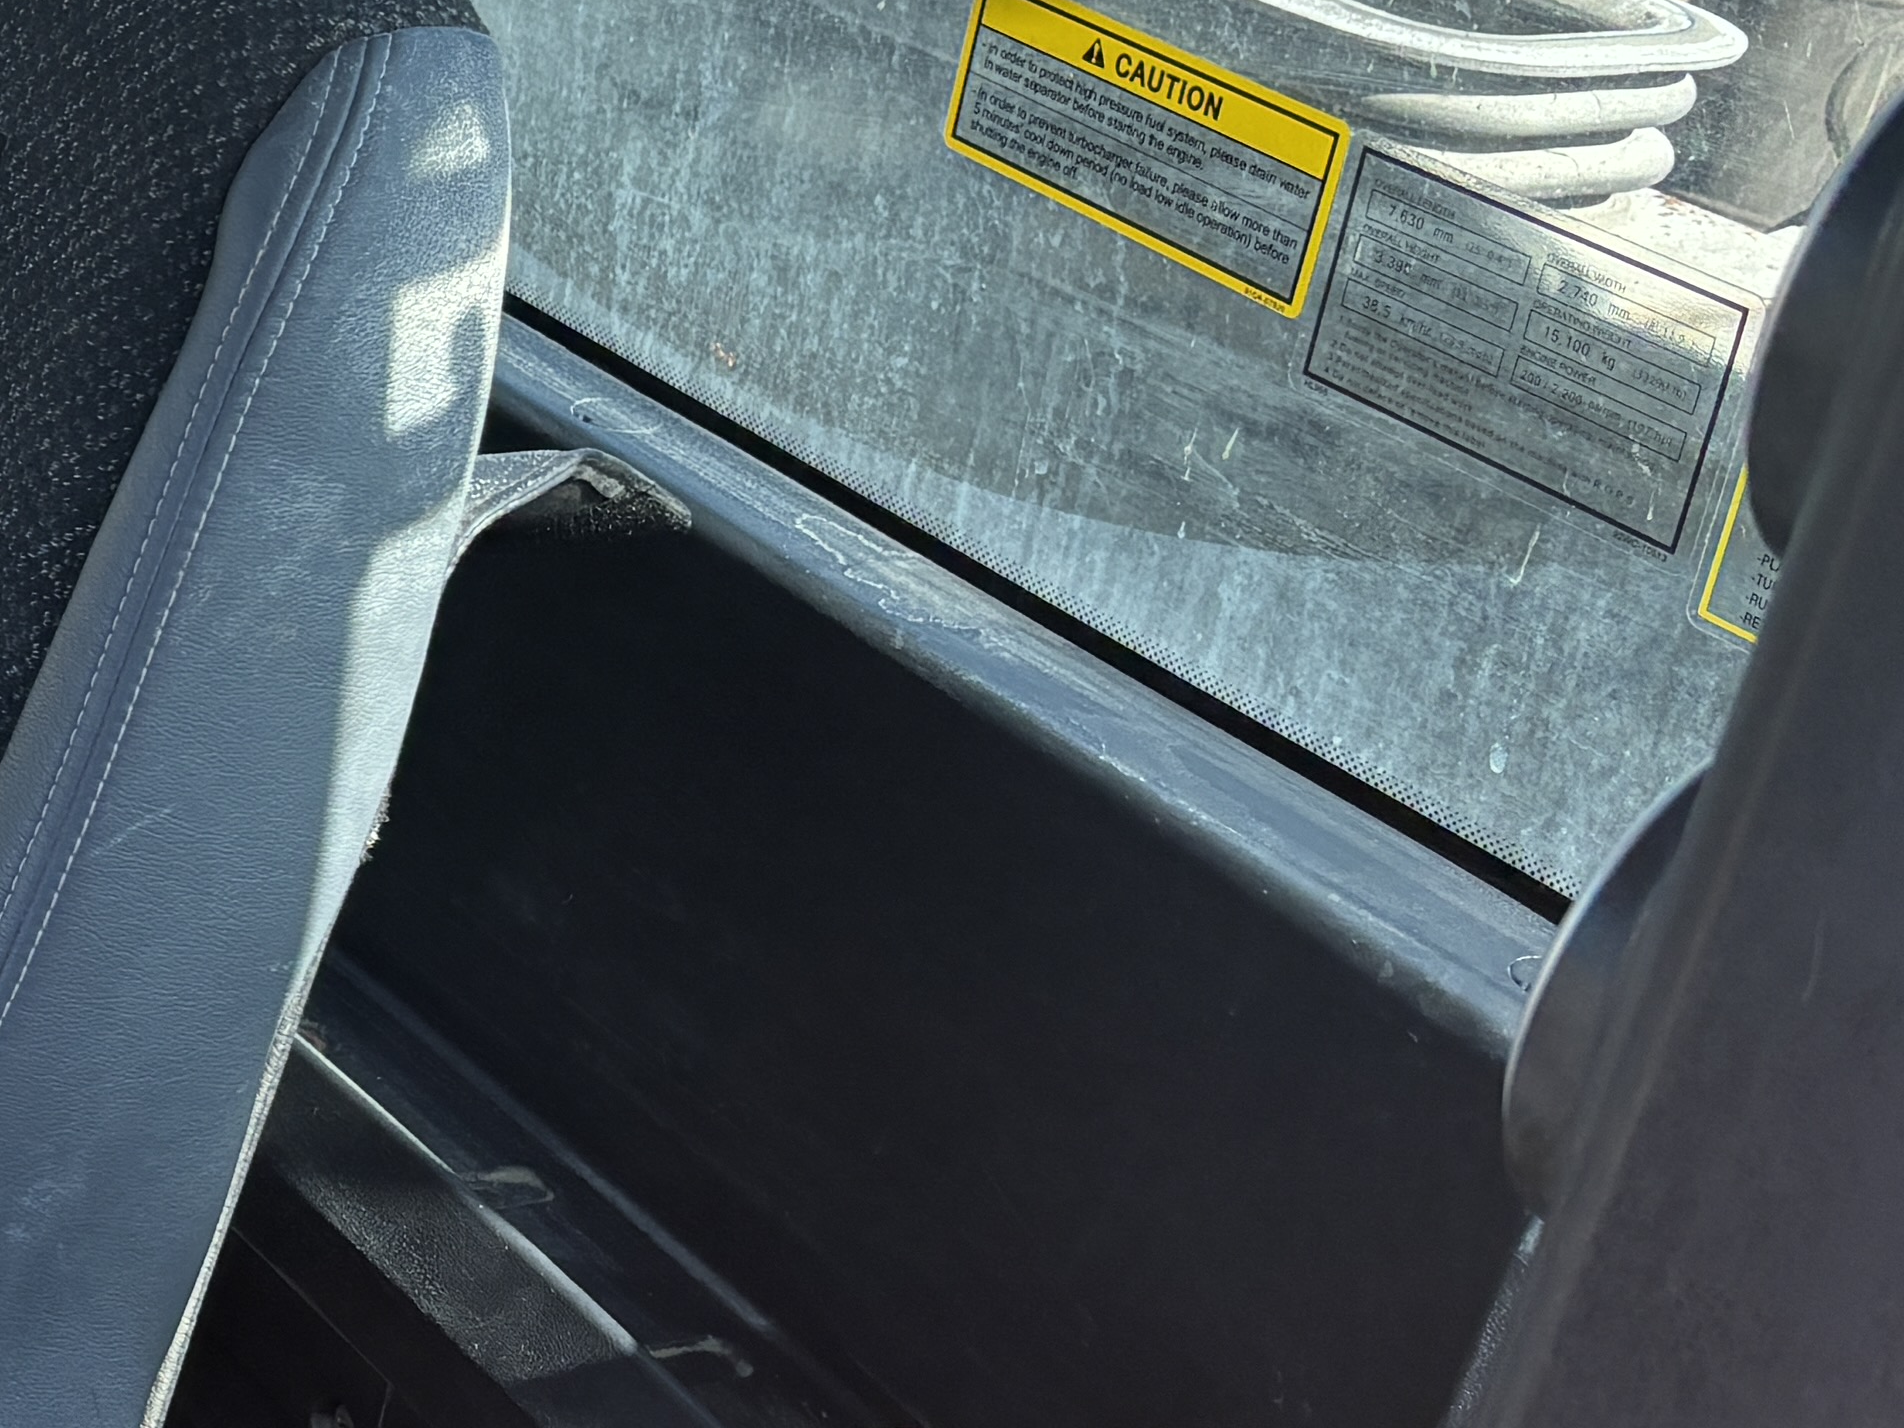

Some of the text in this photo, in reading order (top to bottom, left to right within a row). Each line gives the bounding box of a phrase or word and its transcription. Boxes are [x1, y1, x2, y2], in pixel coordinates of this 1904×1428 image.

[993, 61, 1022, 84] water
[1022, 75, 1071, 109] separator
[1072, 98, 1105, 123] before
[1105, 114, 1146, 145] starting
[1147, 133, 1165, 151] the
[1165, 142, 1205, 173] engine.
[999, 46, 1026, 68] order
[1027, 59, 1038, 74] to
[1038, 64, 1074, 93] protect
[1074, 81, 1098, 104] high
[1097, 94, 1143, 126] pressure
[1144, 113, 1166, 133] fuel
[1165, 123, 1208, 156] system,
[1209, 143, 1247, 174] please
[1247, 161, 1277, 185] drain
[1278, 176, 1311, 201] water
[1113, 50, 1224, 121] CAUTION
[969, 118, 1007, 148] shutting
[1008, 137, 1025, 154] the
[1026, 146, 1061, 174] engine
[973, 102, 981, 114] 5
[1023, 126, 1045, 146] cool
[1046, 137, 1074, 160] down
[1074, 151, 1108, 179] period
[1108, 168, 1128, 189] (no
[1128, 177, 1152, 198] load
[1153, 189, 1173, 208] low
[1174, 199, 1195, 219] idle
[1195, 210, 1252, 249] operation)
[1253, 238, 1290, 266] before
[988, 92, 1016, 114] order
[1016, 105, 1027, 120] to
[1028, 111, 1066, 141] prevent
[1067, 130, 1132, 173] turbocharger
[1133, 162, 1171, 191] failure,
[1171, 180, 1209, 210] please
[1210, 198, 1240, 223] allow
[1241, 216, 1270, 238] more
[1271, 228, 1298, 251] than
[1432, 226, 1454, 244] mm
[1607, 302, 1631, 321] mm
